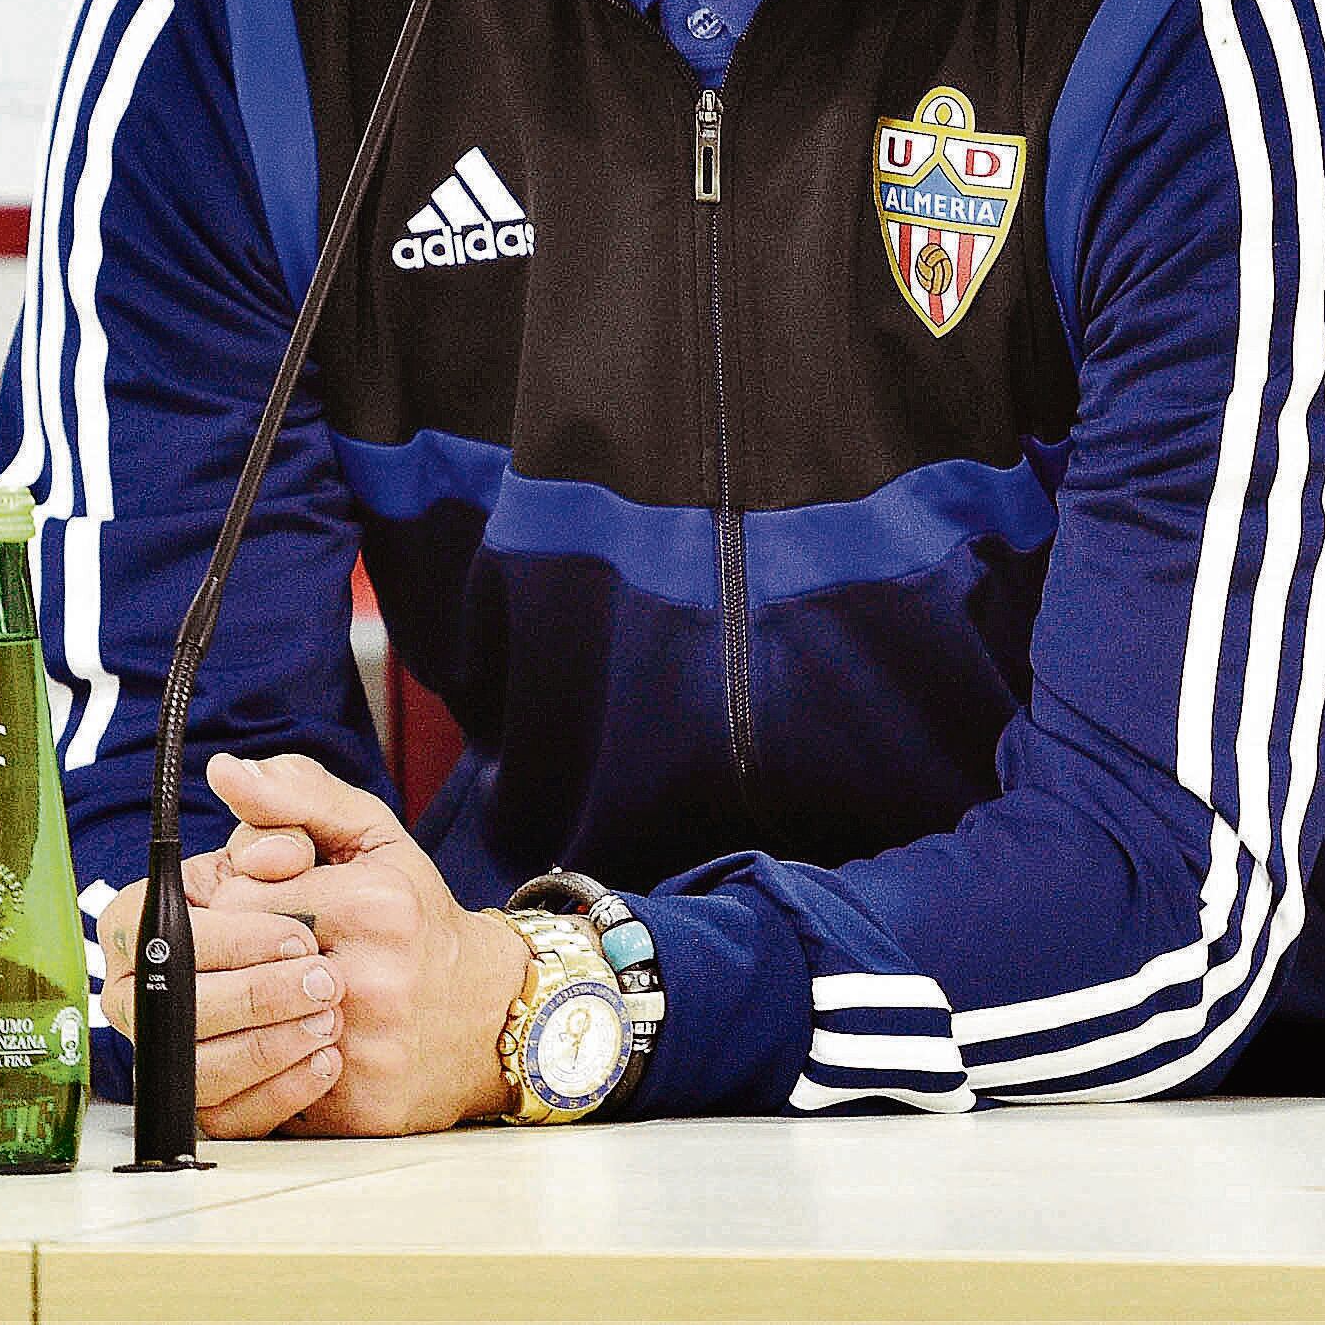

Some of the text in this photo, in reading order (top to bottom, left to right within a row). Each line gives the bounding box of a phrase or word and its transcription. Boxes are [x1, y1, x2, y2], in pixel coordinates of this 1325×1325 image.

[887, 136, 1001, 178] U D
[884, 186, 997, 225] ALMERIA
[4, 1054, 33, 1068] FINA
